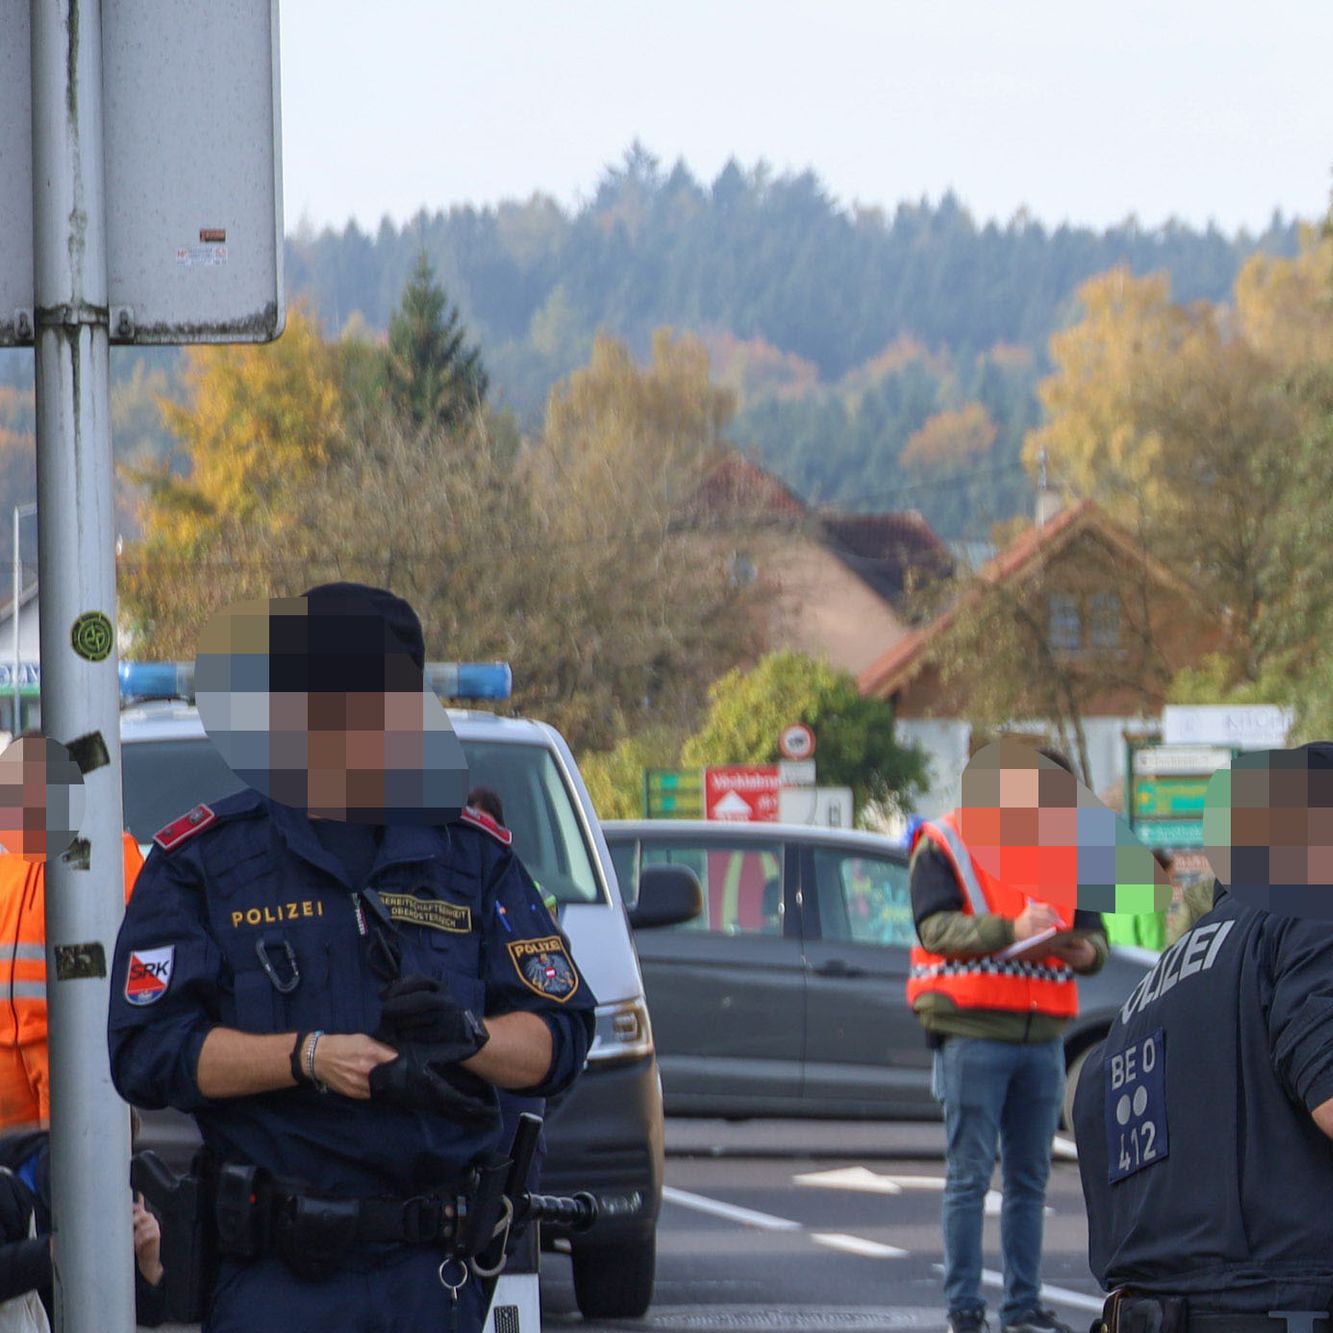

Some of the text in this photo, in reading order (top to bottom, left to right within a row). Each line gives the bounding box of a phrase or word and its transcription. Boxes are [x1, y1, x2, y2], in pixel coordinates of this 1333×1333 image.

[231, 900, 324, 929] POLIZEI
[131, 959, 170, 981] SRK
[1119, 919, 1236, 1025] OLIZEI
[1111, 1046, 1137, 1091] BE
[1118, 1120, 1157, 1172] 412
